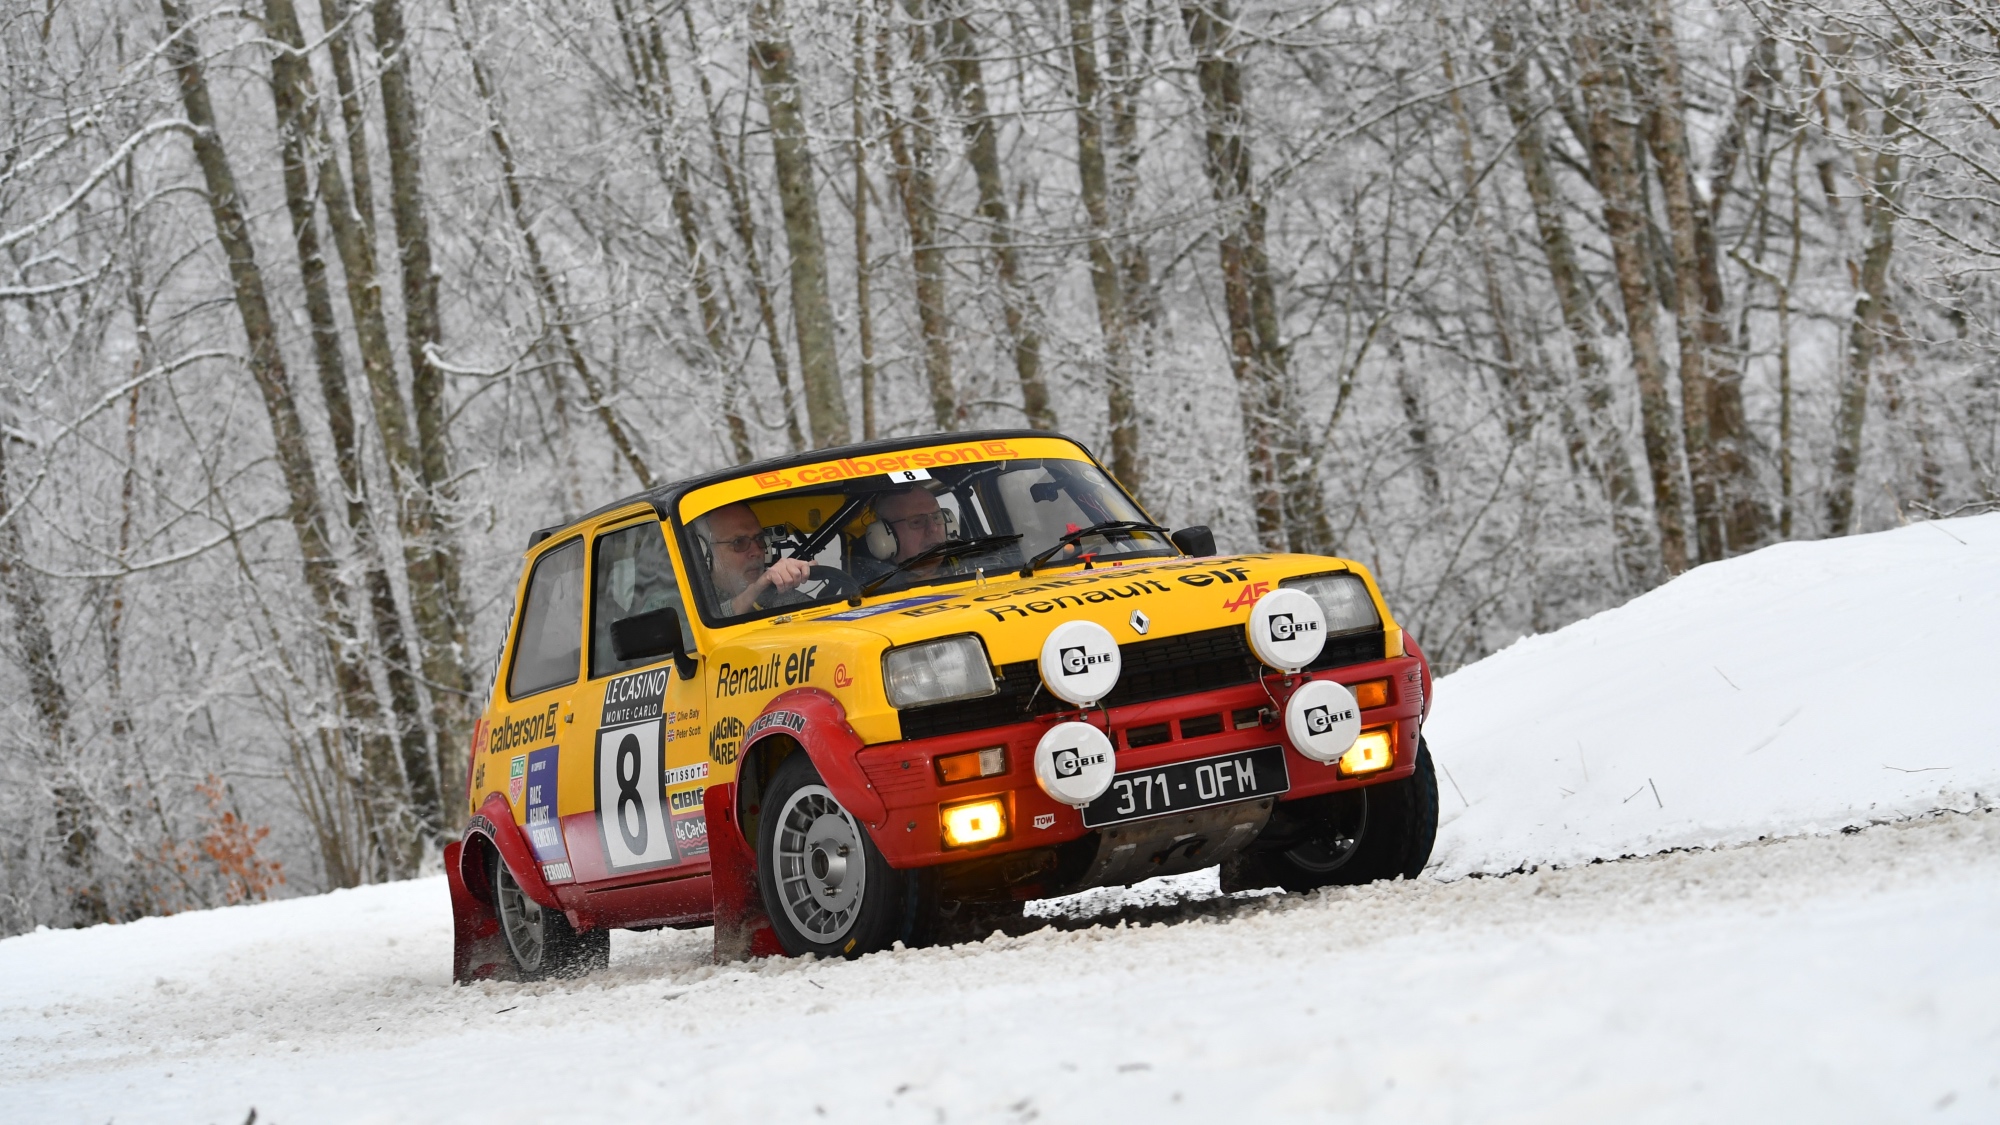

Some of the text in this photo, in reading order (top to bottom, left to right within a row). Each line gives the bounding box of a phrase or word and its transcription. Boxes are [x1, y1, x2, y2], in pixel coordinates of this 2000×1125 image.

[796, 446, 985, 485] calberson
[903, 470, 917, 481] 8
[974, 553, 1273, 602] calberson
[985, 566, 1251, 622] Renault elf
[716, 645, 818, 698] Renault elf
[606, 670, 666, 705] LE CASINO
[490, 713, 545, 755] calberson
[676, 726, 702, 740] Peter Scott
[745, 711, 806, 744] MICHELIN
[511, 761, 525, 776] TAG
[671, 767, 701, 782] TISSOT
[530, 785, 541, 805] RACE
[616, 733, 648, 856] 8
[530, 805, 550, 827] AGAINST
[1036, 815, 1053, 826] TOW
[533, 826, 559, 849] DEMENTIA
[676, 819, 707, 840] de Carbo
[543, 862, 572, 881] FERODO
